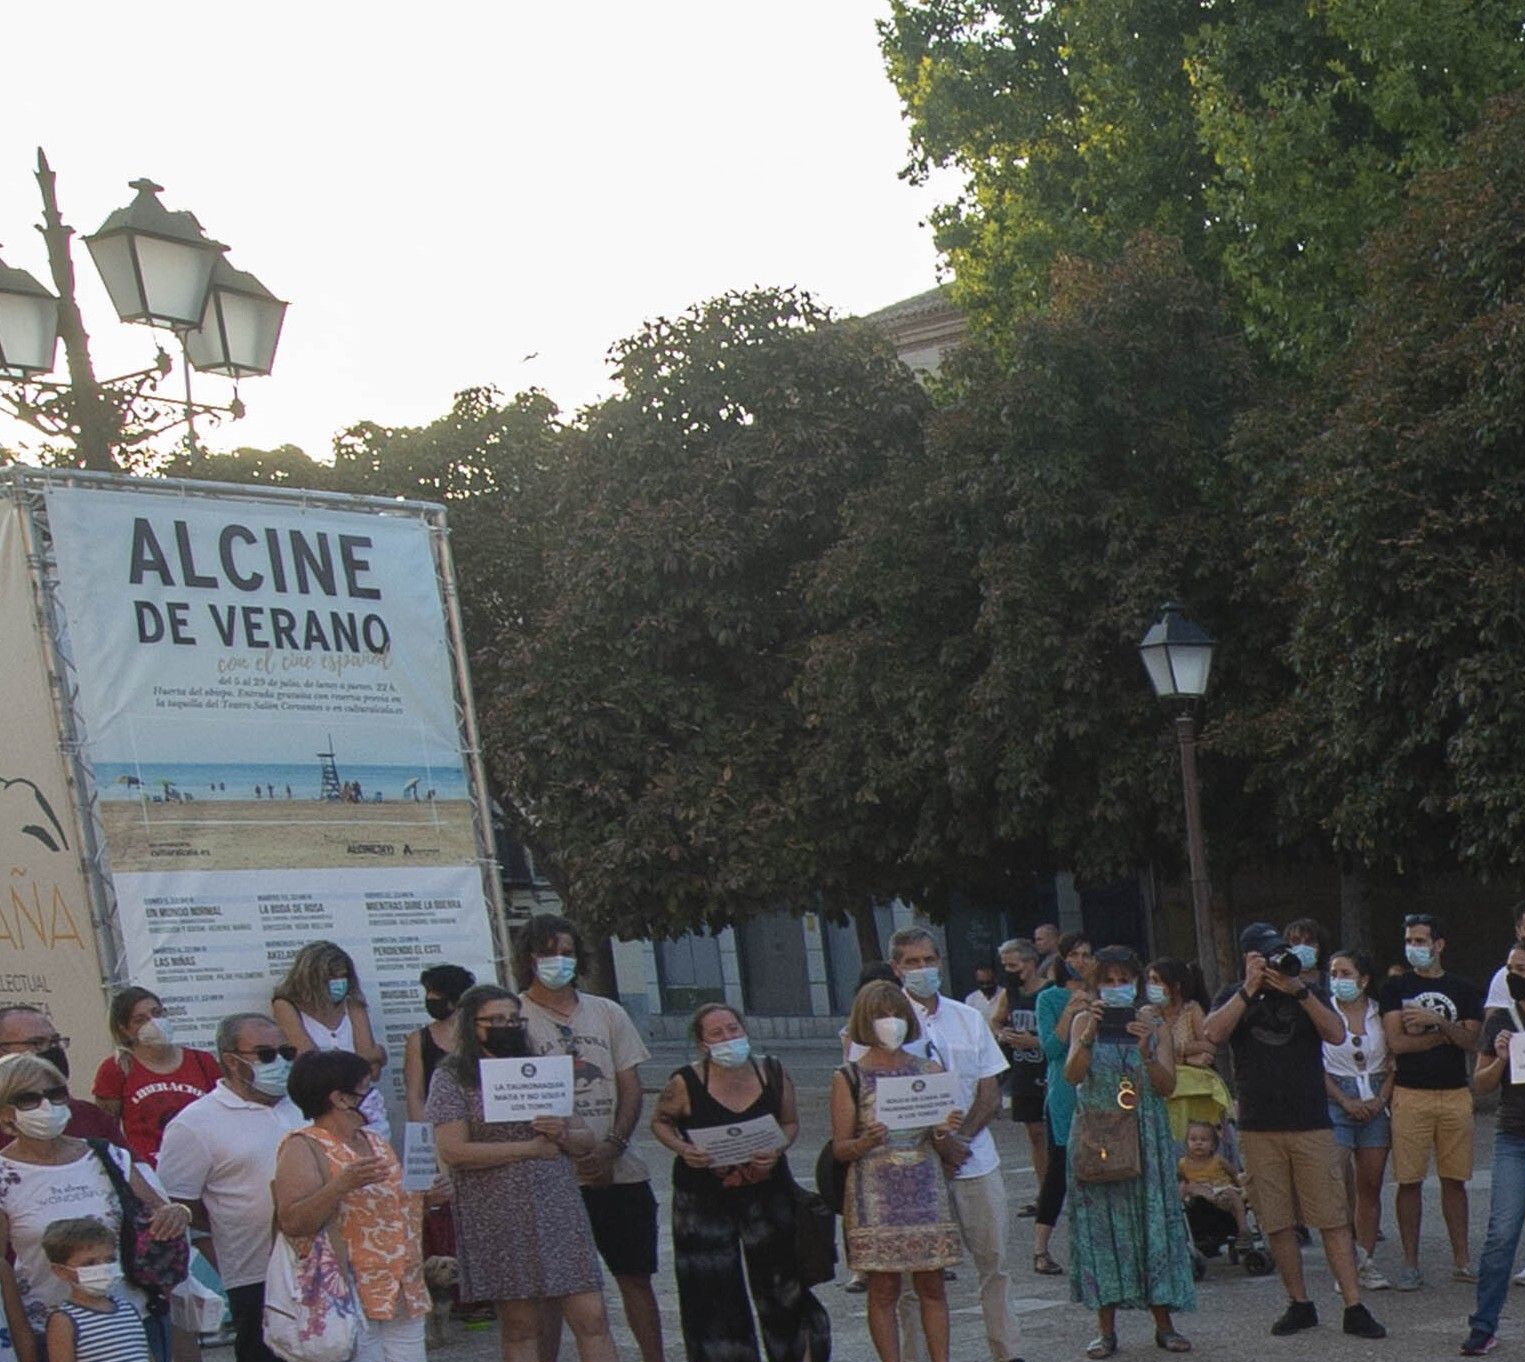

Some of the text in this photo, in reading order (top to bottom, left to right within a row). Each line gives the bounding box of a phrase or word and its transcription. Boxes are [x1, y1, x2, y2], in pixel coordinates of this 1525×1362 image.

[129, 517, 382, 600] ALCINE
[134, 600, 391, 655] DE VERANO
